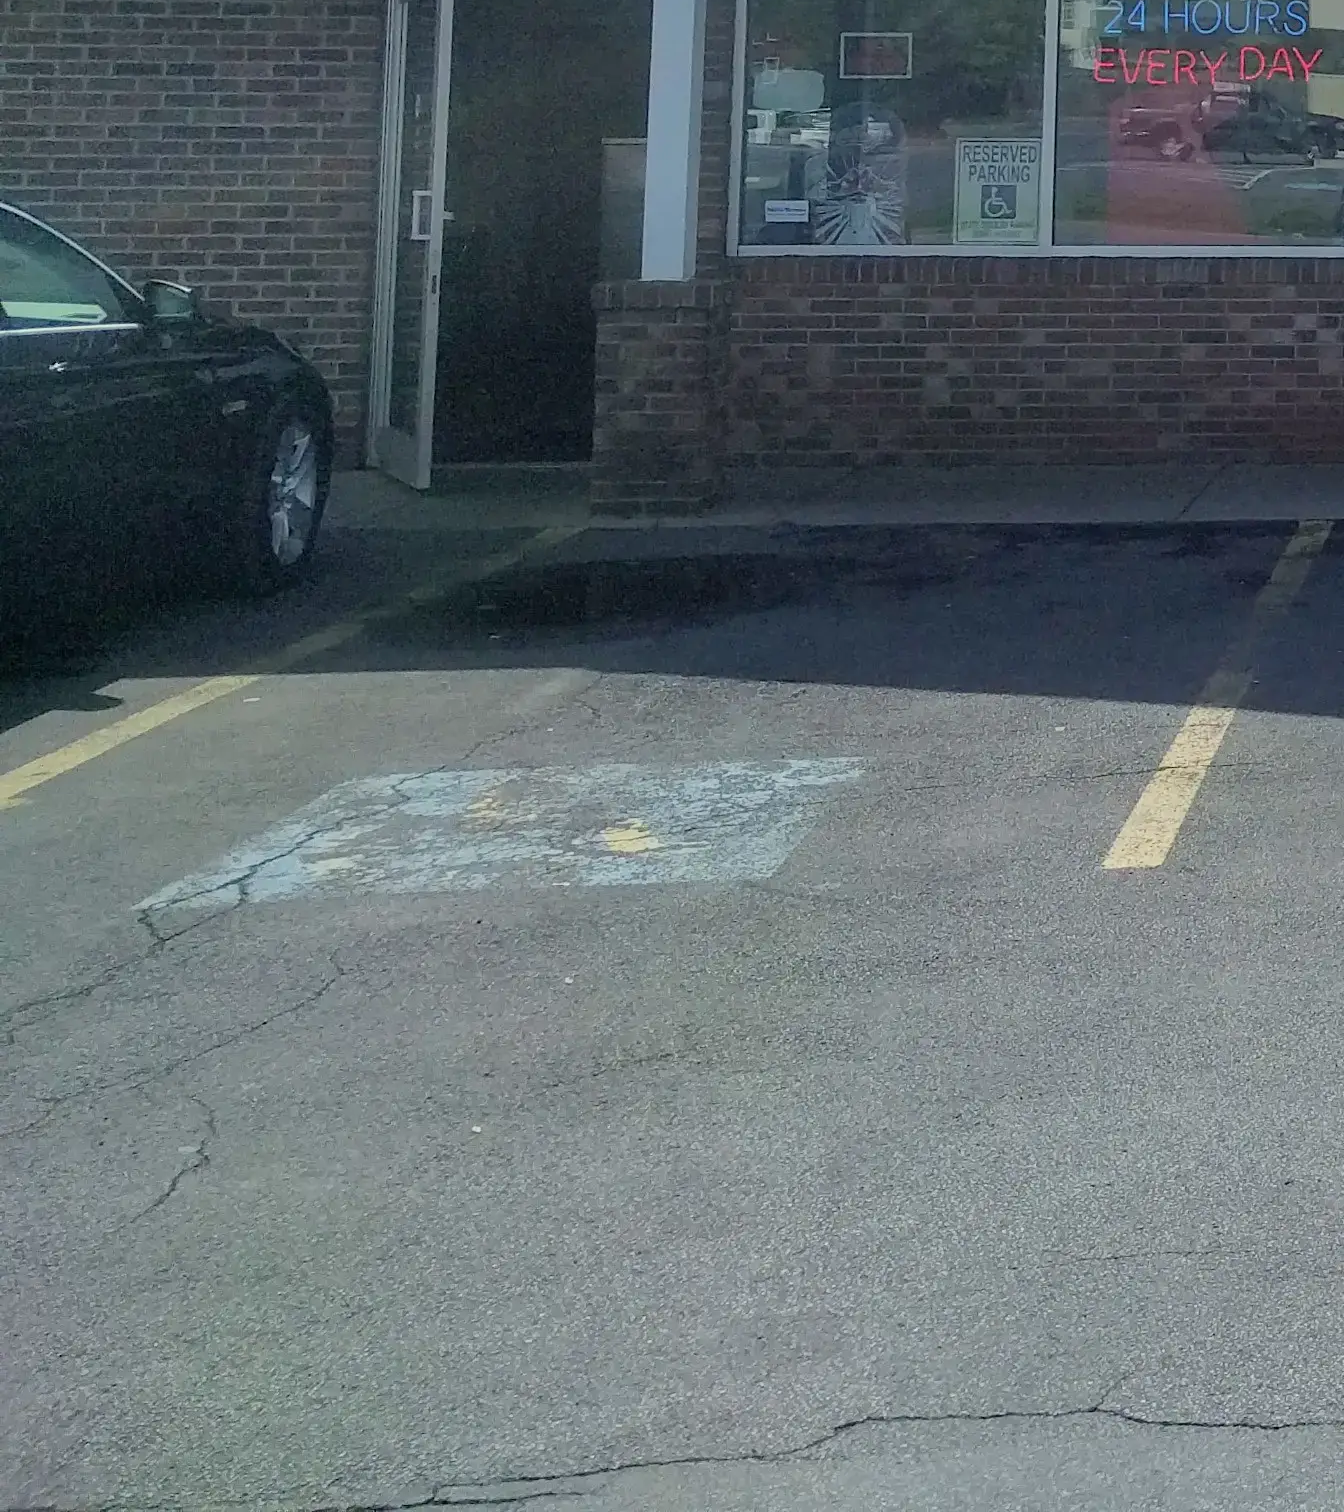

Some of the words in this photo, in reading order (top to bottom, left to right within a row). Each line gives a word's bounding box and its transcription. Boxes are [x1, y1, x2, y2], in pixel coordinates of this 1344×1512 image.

[1092, 46, 1228, 86] EVERY
[1239, 45, 1324, 84] DAY
[962, 144, 1038, 163] RESERVED
[968, 165, 1031, 183] PARKING
